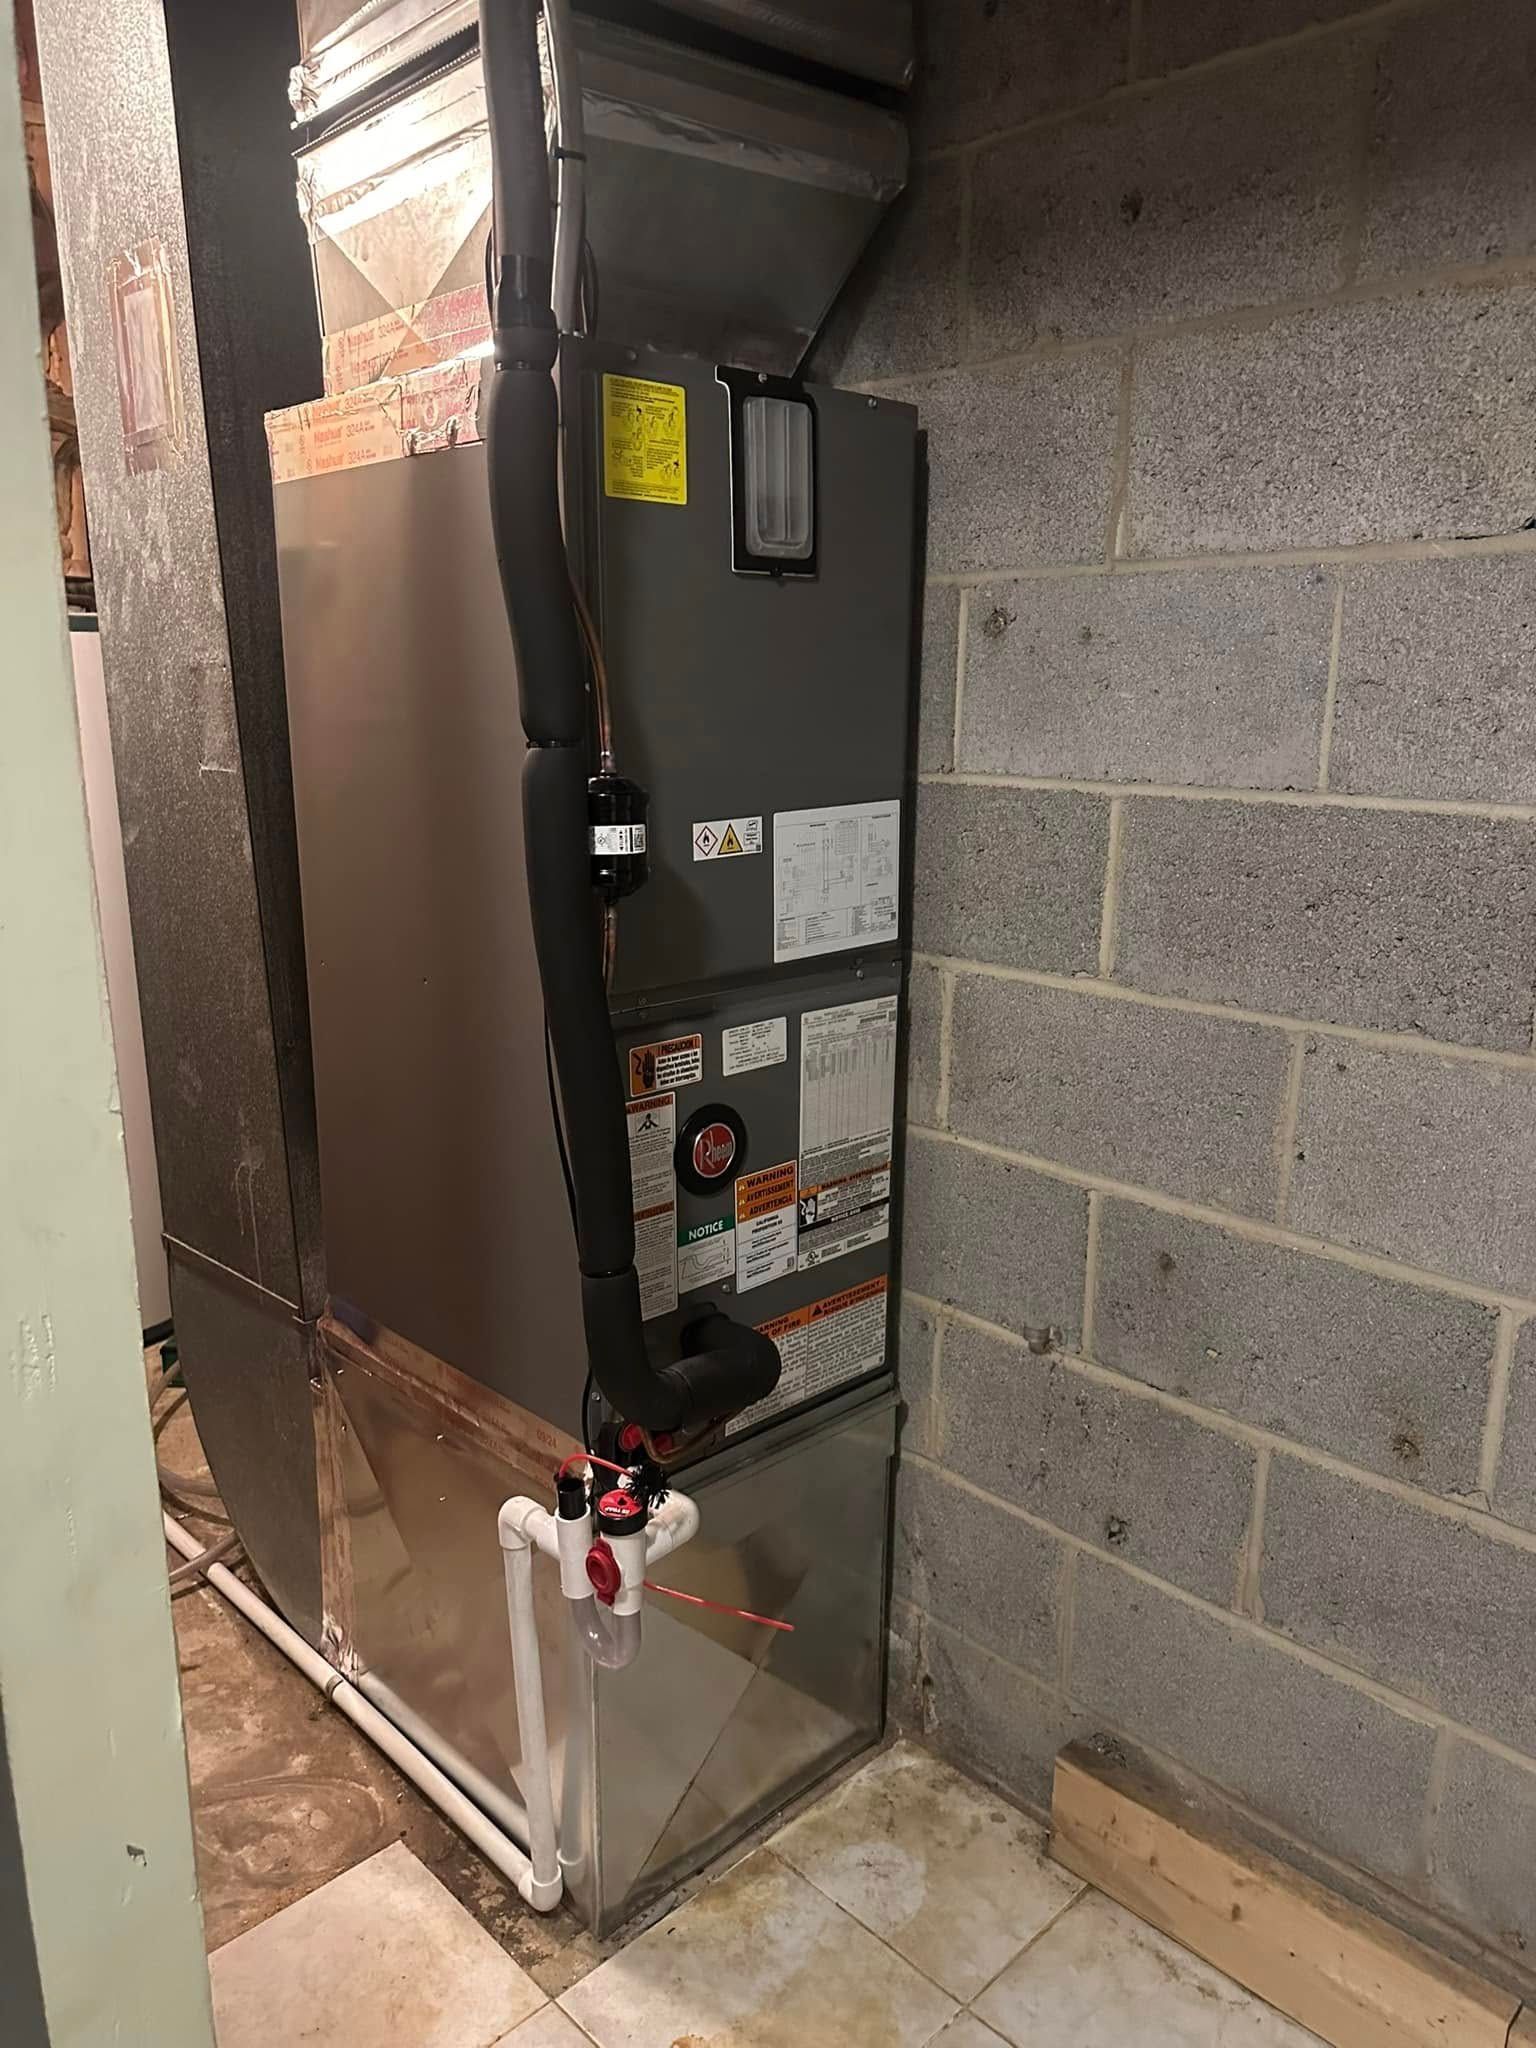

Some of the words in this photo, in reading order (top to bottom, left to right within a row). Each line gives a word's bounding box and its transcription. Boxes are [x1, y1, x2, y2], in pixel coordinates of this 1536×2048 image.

[746, 1166, 793, 1188] WARNING
[746, 1179, 793, 1202] AVERTISSEMENT
[688, 1219, 725, 1241] NOTICE
[758, 1317, 789, 1333] ARNING
